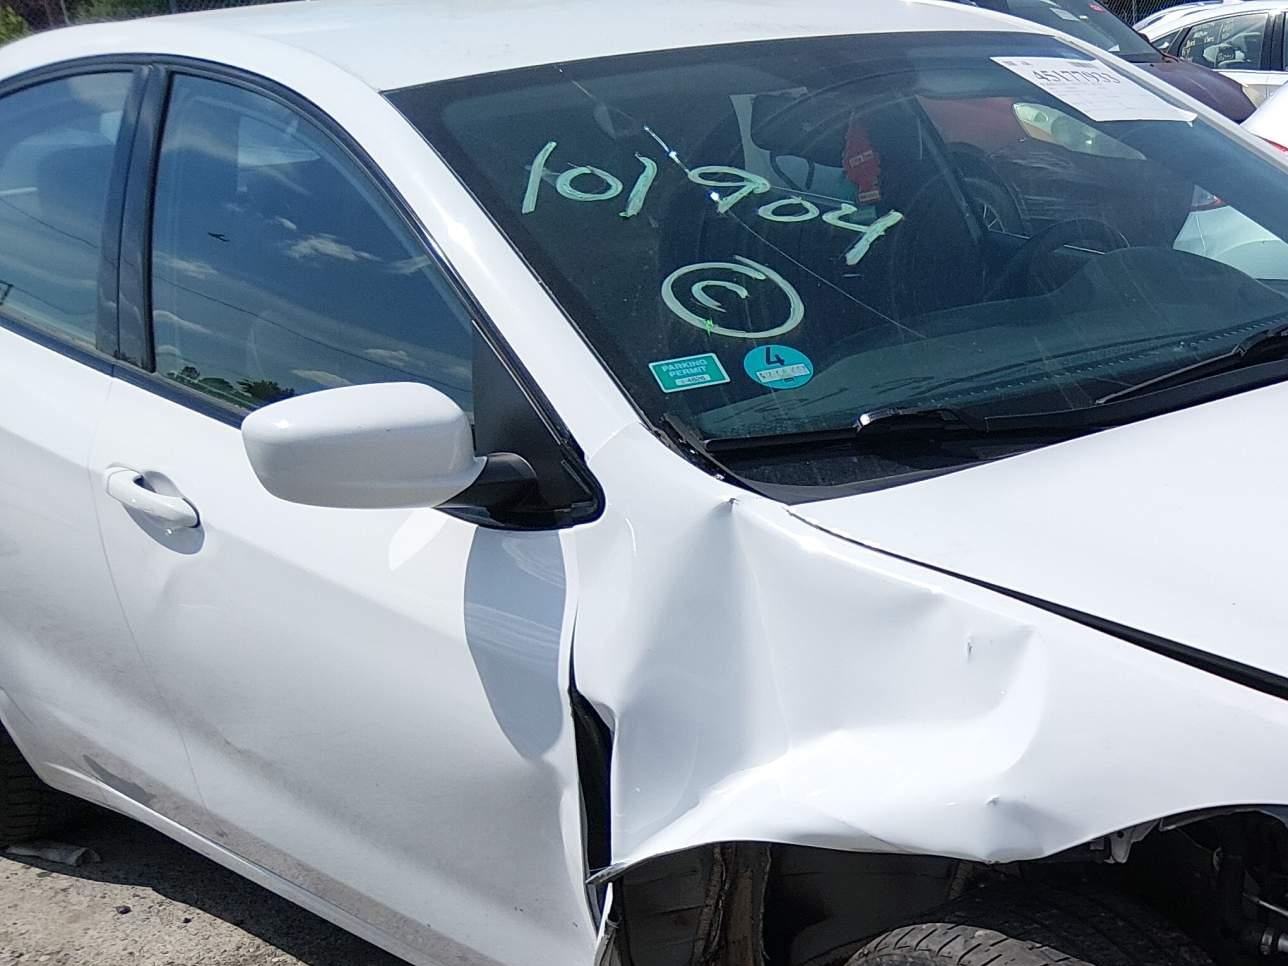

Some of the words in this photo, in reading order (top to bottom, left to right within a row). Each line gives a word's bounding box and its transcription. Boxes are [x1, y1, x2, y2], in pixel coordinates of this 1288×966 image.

[1032, 70, 1121, 83] 45177933
[765, 346, 785, 366] 4
[661, 359, 708, 372] PARKING
[669, 365, 707, 377] PERMIT
